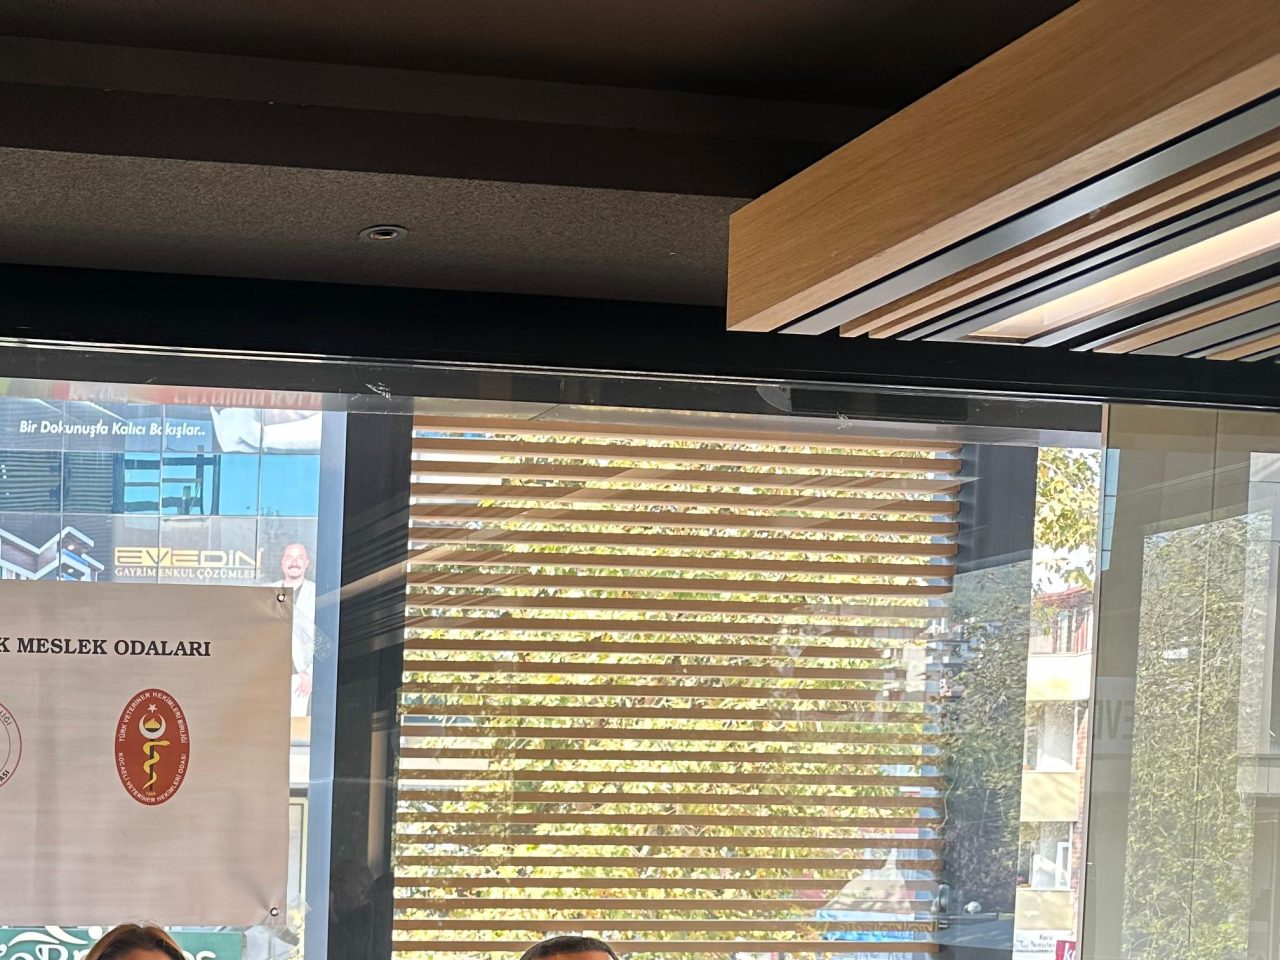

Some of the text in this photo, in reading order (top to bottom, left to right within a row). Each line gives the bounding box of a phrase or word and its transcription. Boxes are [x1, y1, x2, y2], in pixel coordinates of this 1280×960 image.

[20, 420, 36, 433] Bir
[40, 421, 108, 438] Dokunuşta
[112, 422, 146, 435] Kalıcı
[115, 567, 195, 578] GAYRİMENKUL
[17, 636, 108, 655] MESLEK
[113, 639, 212, 657] ODALARI
